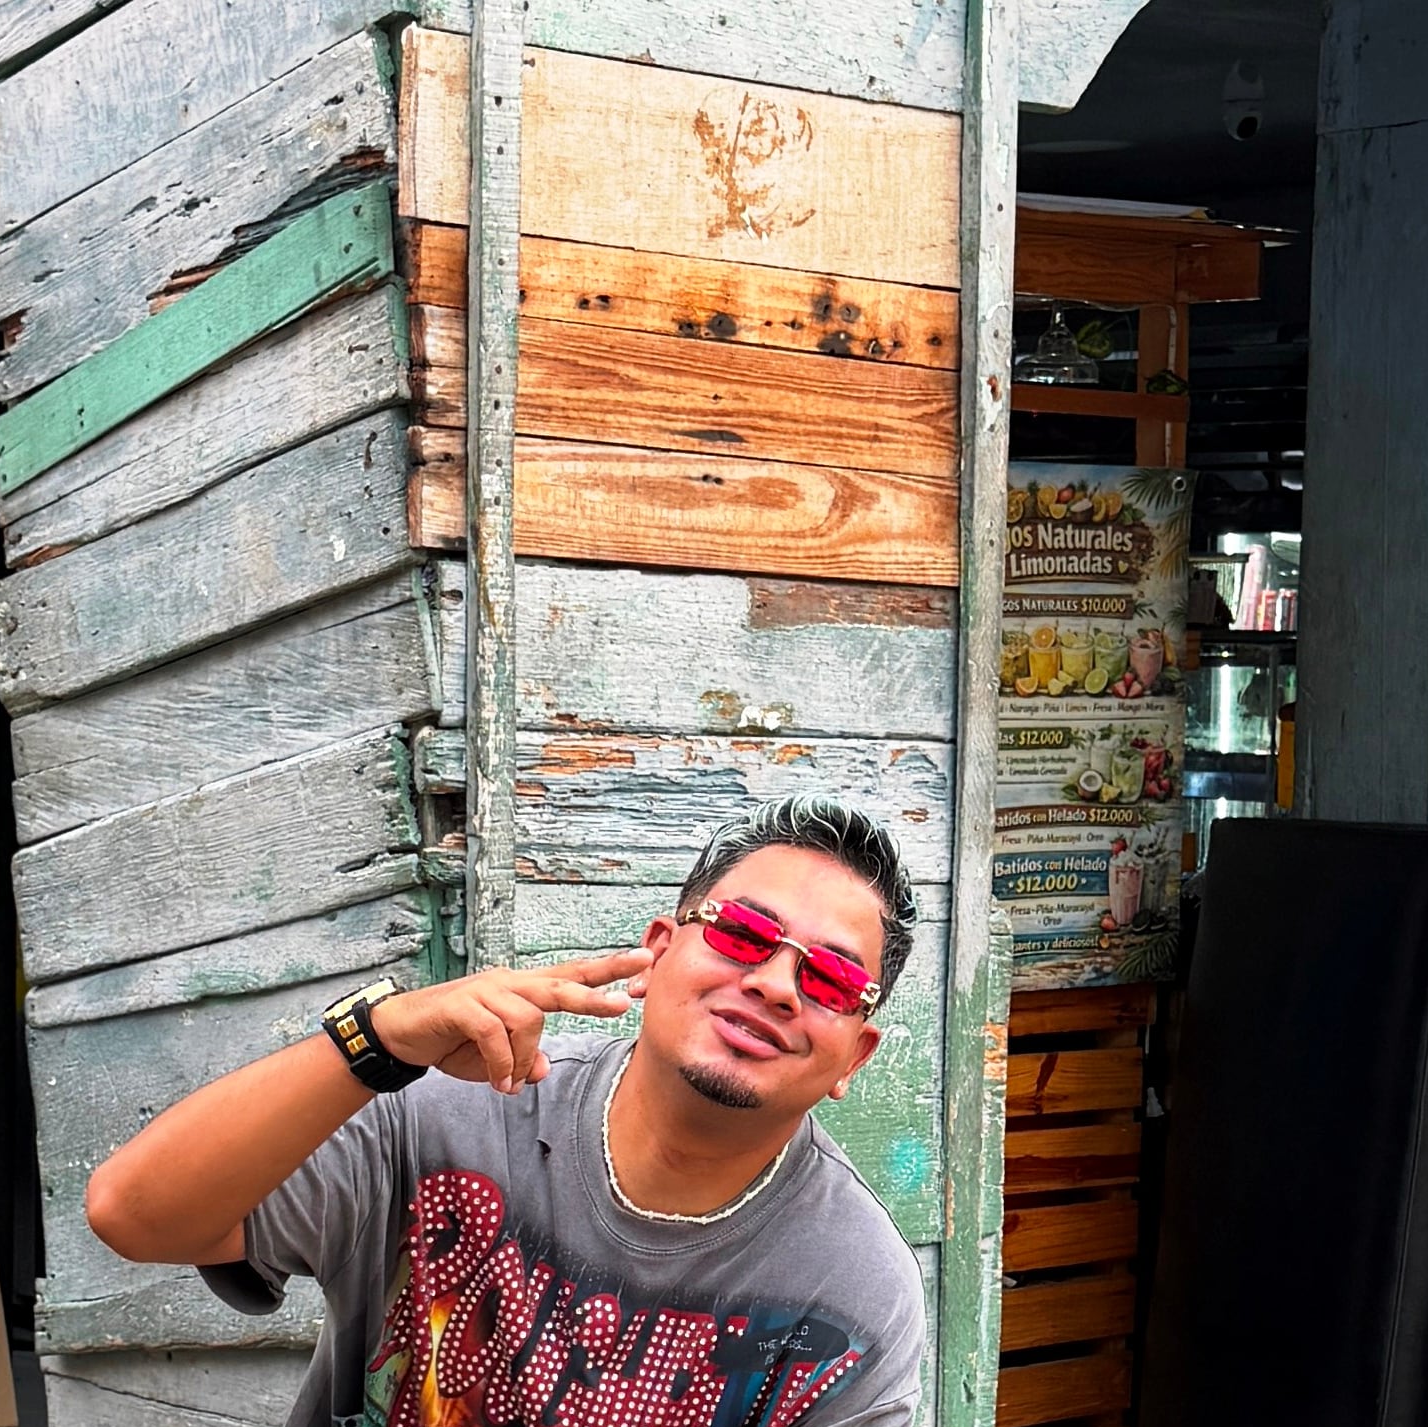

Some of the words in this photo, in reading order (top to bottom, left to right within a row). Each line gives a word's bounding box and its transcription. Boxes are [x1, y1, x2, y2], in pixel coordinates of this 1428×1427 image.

[1037, 522, 1133, 552] Naturales
[1009, 551, 1113, 578] Limonadas
[1080, 598, 1126, 613] $10.000
[1018, 729, 1064, 746] $12.000
[994, 811, 1031, 828] atidos
[1048, 808, 1087, 823] Helado
[1088, 808, 1133, 823] $12.000
[994, 857, 1043, 877] Batidos
[1044, 860, 1062, 871] con
[1064, 856, 1107, 872] Helado
[1015, 873, 1078, 893] $12.000
